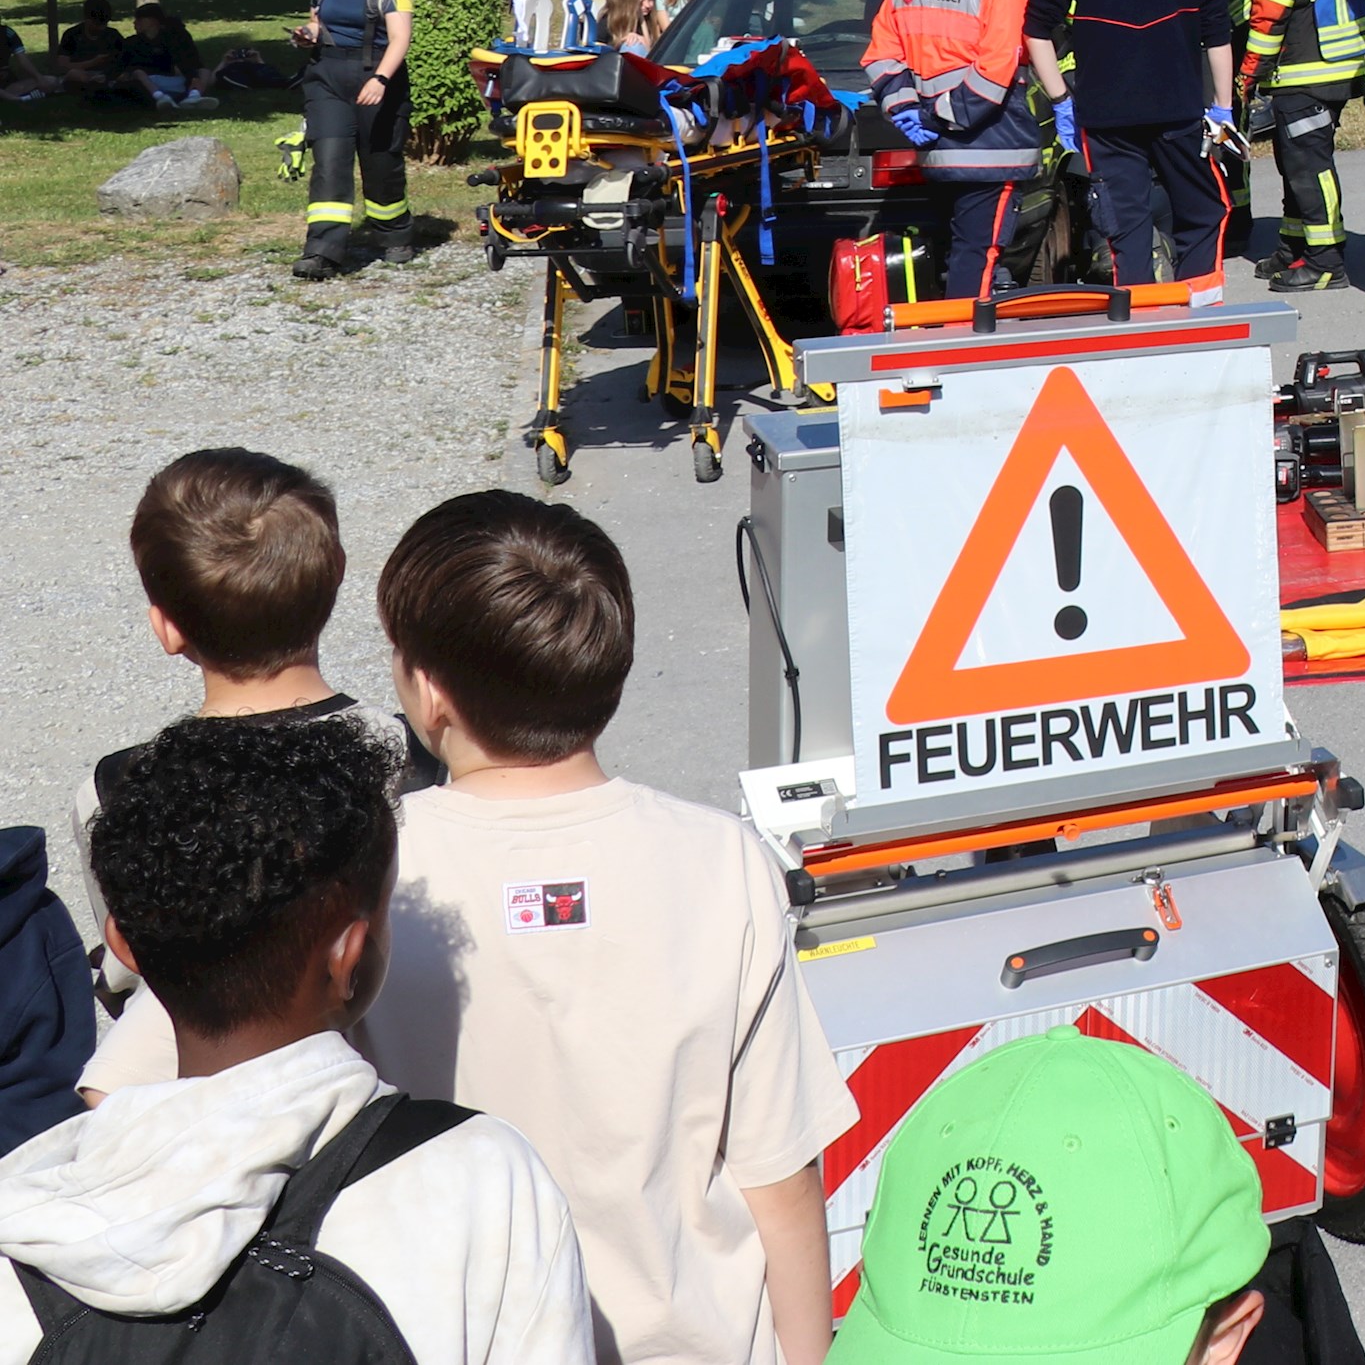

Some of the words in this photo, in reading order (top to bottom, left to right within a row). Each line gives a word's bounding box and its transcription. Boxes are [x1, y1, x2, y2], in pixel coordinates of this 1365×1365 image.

[879, 683, 1260, 790] FEUERWEHR
[511, 893, 541, 904] BULLS
[809, 940, 861, 958] WARNLEUCHTE
[858, 1159, 871, 1172] 3M
[941, 1163, 961, 1188] MIT
[966, 1156, 1003, 1173] KOPF,
[1006, 1162, 1043, 1199] HERZ
[918, 1186, 942, 1252] LERNEN
[1035, 1201, 1048, 1216] &
[1036, 1216, 1054, 1266] HAND
[927, 1242, 1005, 1273] Gesunde
[919, 1276, 1034, 1305] FÜRSTENSTEIN
